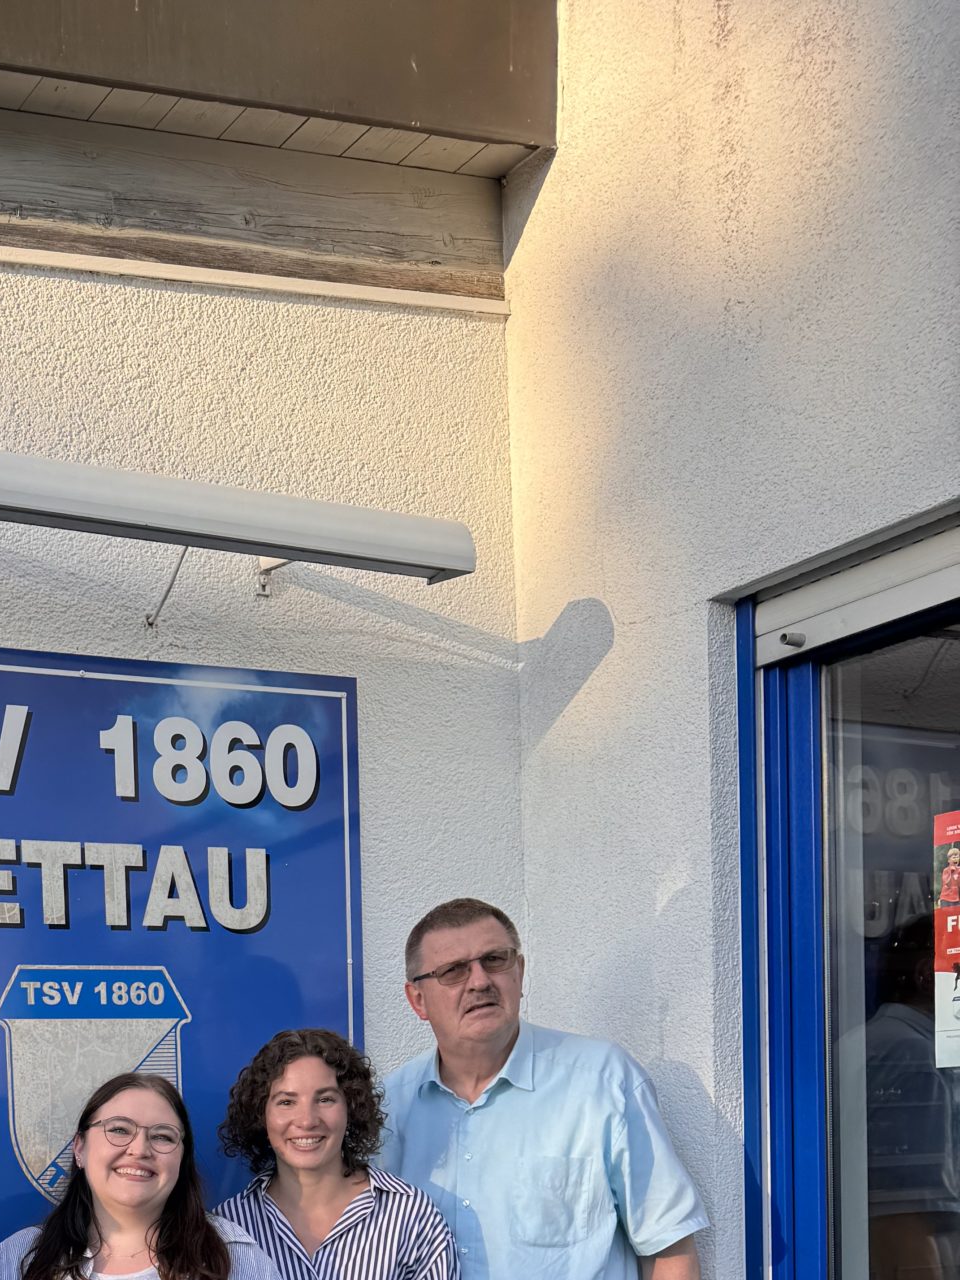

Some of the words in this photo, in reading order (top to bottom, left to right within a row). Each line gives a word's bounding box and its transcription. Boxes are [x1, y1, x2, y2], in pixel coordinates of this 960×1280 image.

[99, 714, 320, 809] 1860
[20, 981, 83, 1006] TSV
[93, 981, 165, 1006] 1860
